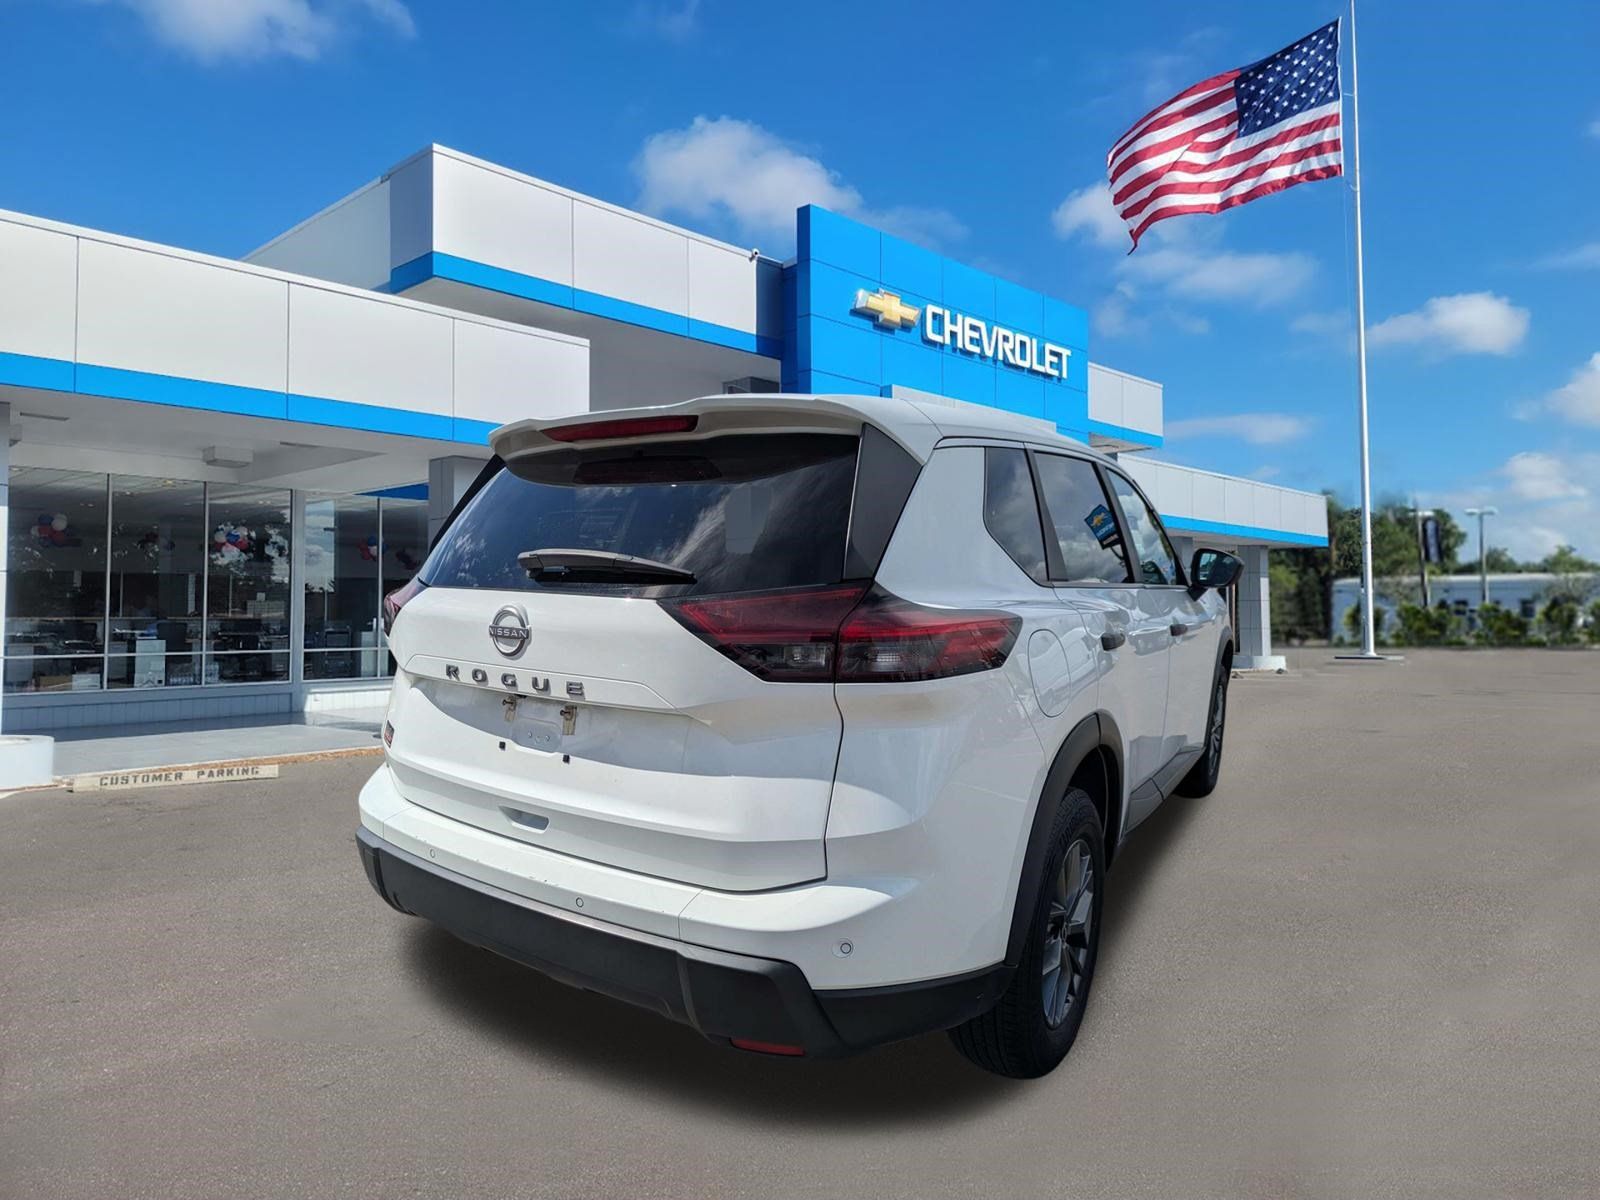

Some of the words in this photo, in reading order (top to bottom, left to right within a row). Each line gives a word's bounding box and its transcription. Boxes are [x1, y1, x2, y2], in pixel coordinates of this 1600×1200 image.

[925, 303, 1072, 380] CHEVROLET
[489, 626, 528, 639] NISSAN
[445, 663, 584, 697] ROGUE
[99, 771, 183, 787] CUSTOMER
[196, 766, 260, 779] PARKING
